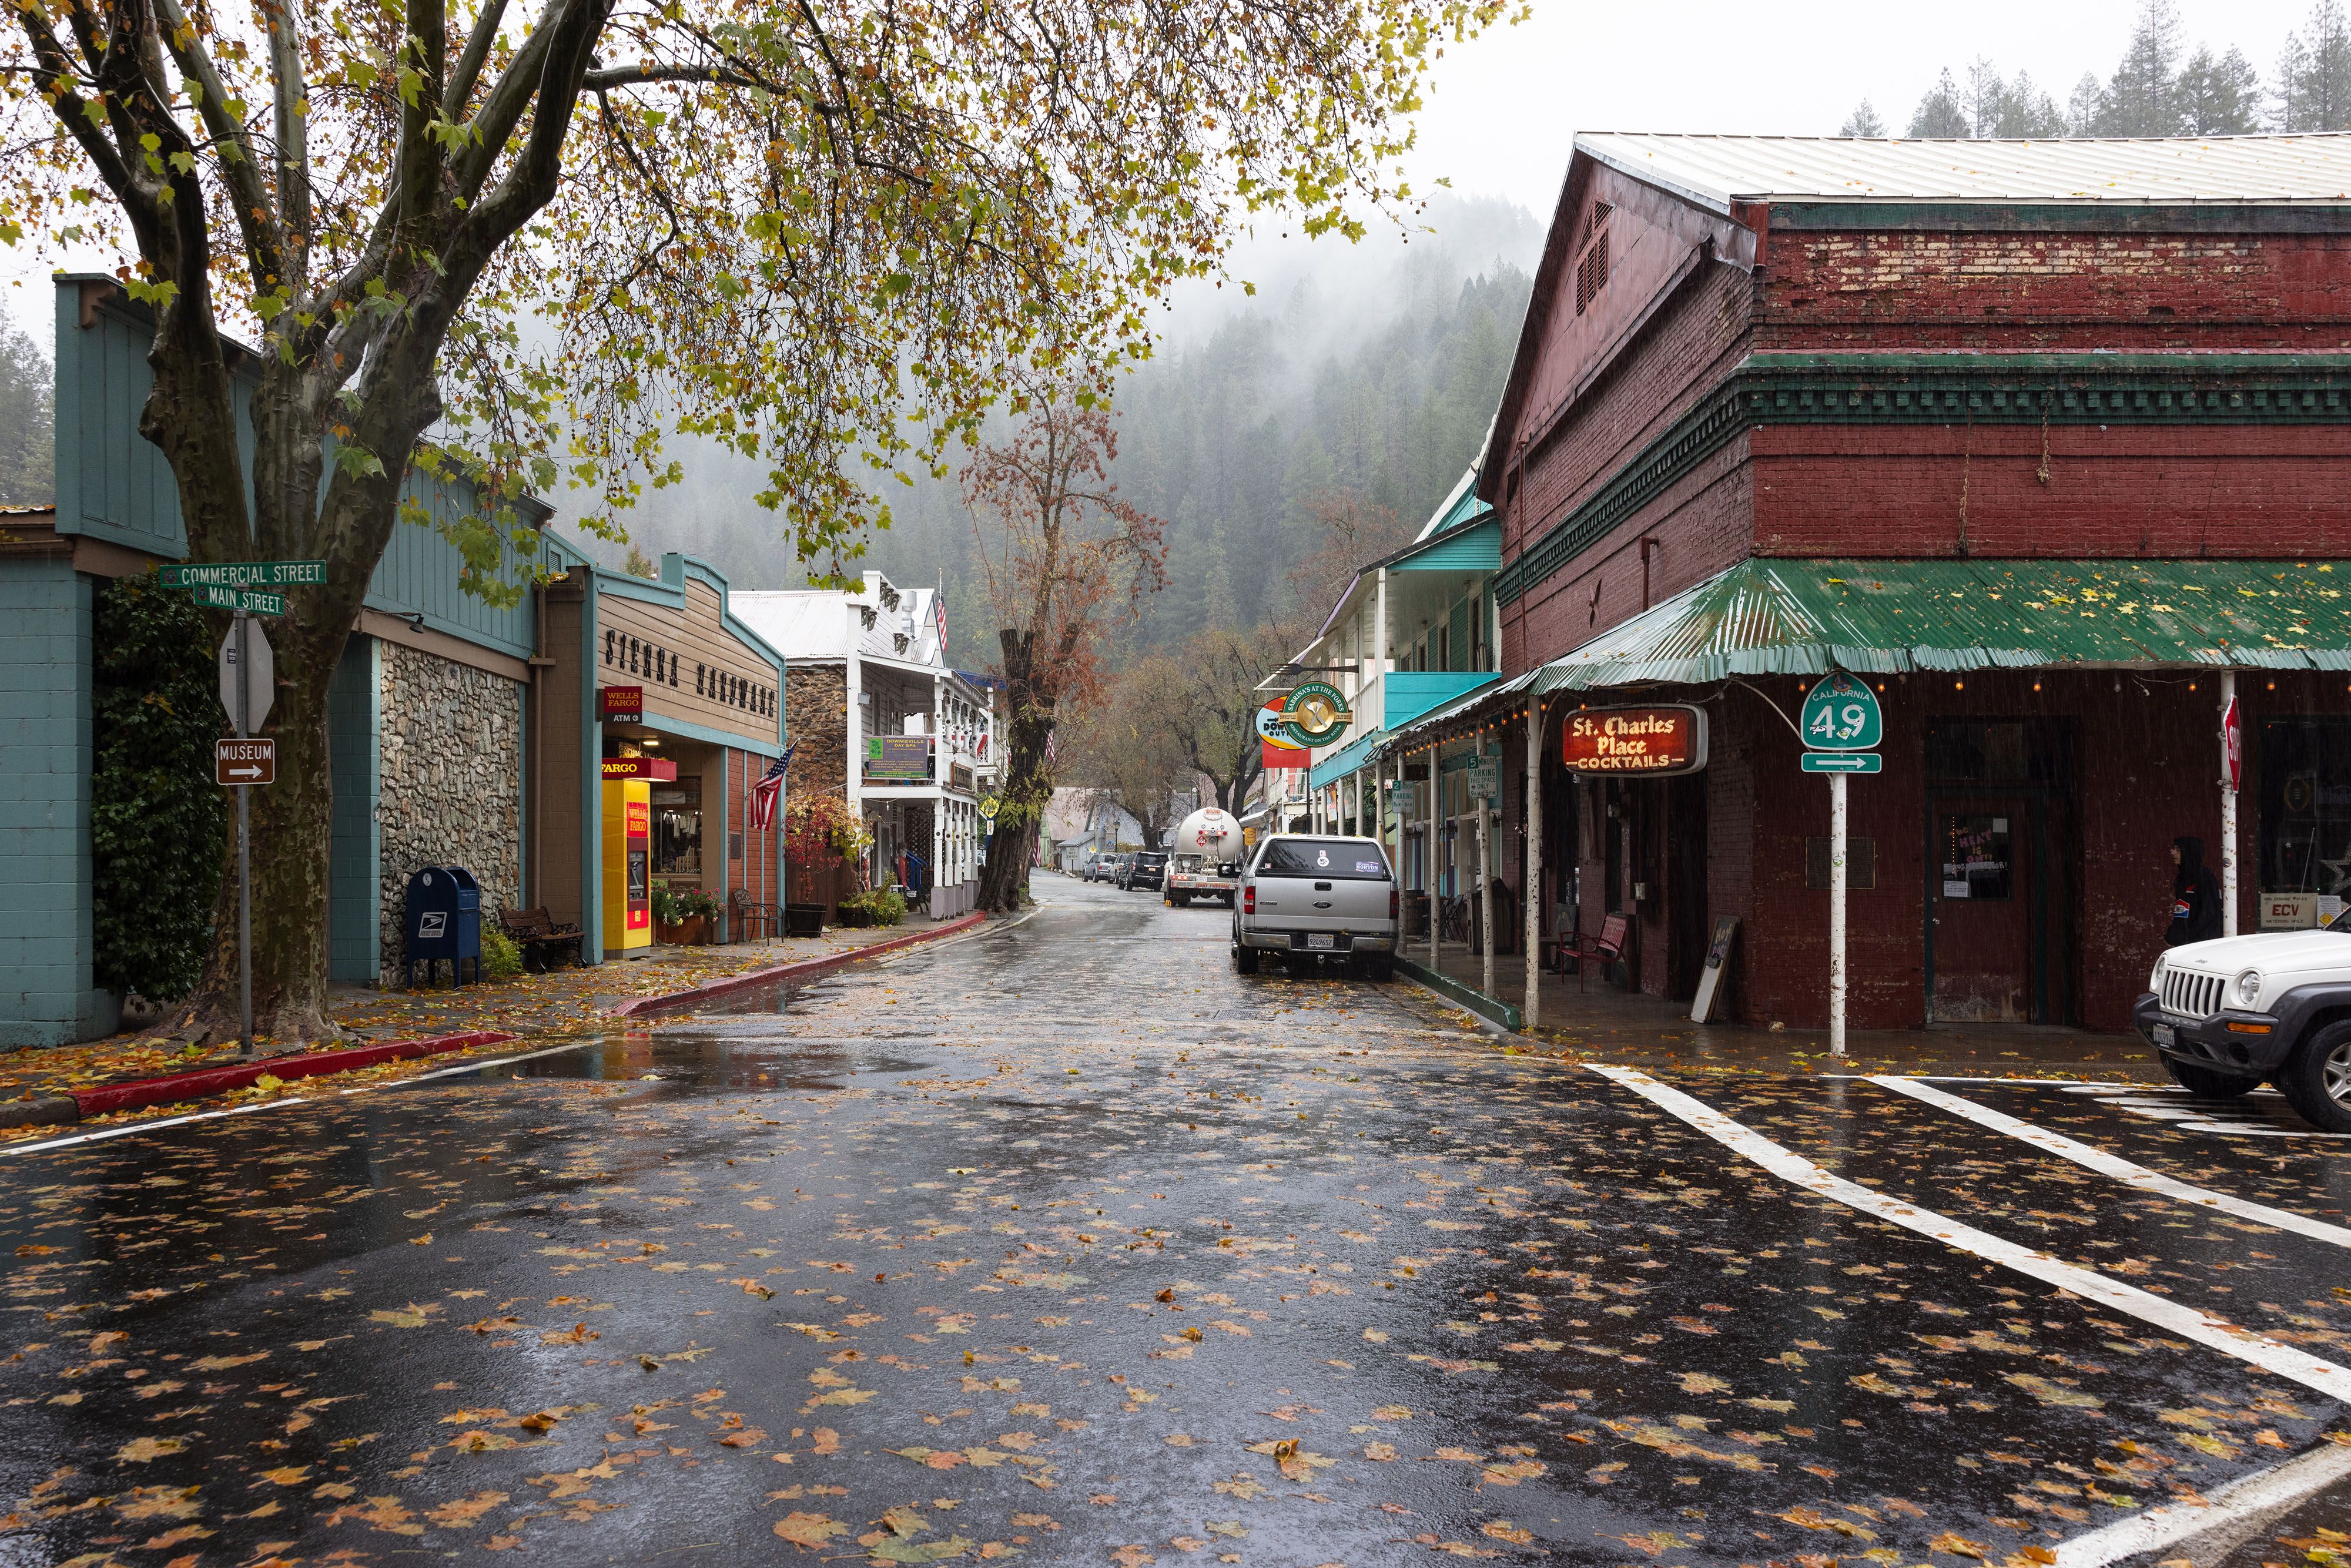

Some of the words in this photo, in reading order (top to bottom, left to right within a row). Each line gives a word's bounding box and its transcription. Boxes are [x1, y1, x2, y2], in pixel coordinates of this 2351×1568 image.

[182, 566, 267, 585] COMMERCIAL
[274, 564, 320, 582] STREET
[209, 587, 236, 606] MAIN
[242, 592, 280, 612] STREET
[605, 628, 678, 688] SIERRA
[696, 662, 775, 718] HARDWARE
[1287, 686, 1311, 711] SABRINA'S
[1320, 686, 1331, 696] THE
[1332, 692, 1344, 712] FORKS
[1812, 689, 1870, 701] CALIFORNIA
[1572, 717, 1599, 737] St.
[1605, 715, 1675, 736] Charles
[1810, 704, 1866, 739] 49
[1290, 723, 1314, 742] RESTAURANT
[1331, 724, 1342, 737] RIVER
[220, 745, 272, 760] MUSEUM
[1597, 736, 1647, 756] Place
[2229, 725, 2240, 762] STOP
[1470, 758, 1476, 768] 5
[1578, 755, 1669, 769] COCKTAILS
[1469, 768, 1496, 778] PARKING
[629, 808, 647, 820] WELLS
[629, 820, 647, 832] FARGO
[1959, 828, 1992, 847] HEAT
[2272, 904, 2299, 916] ECV
